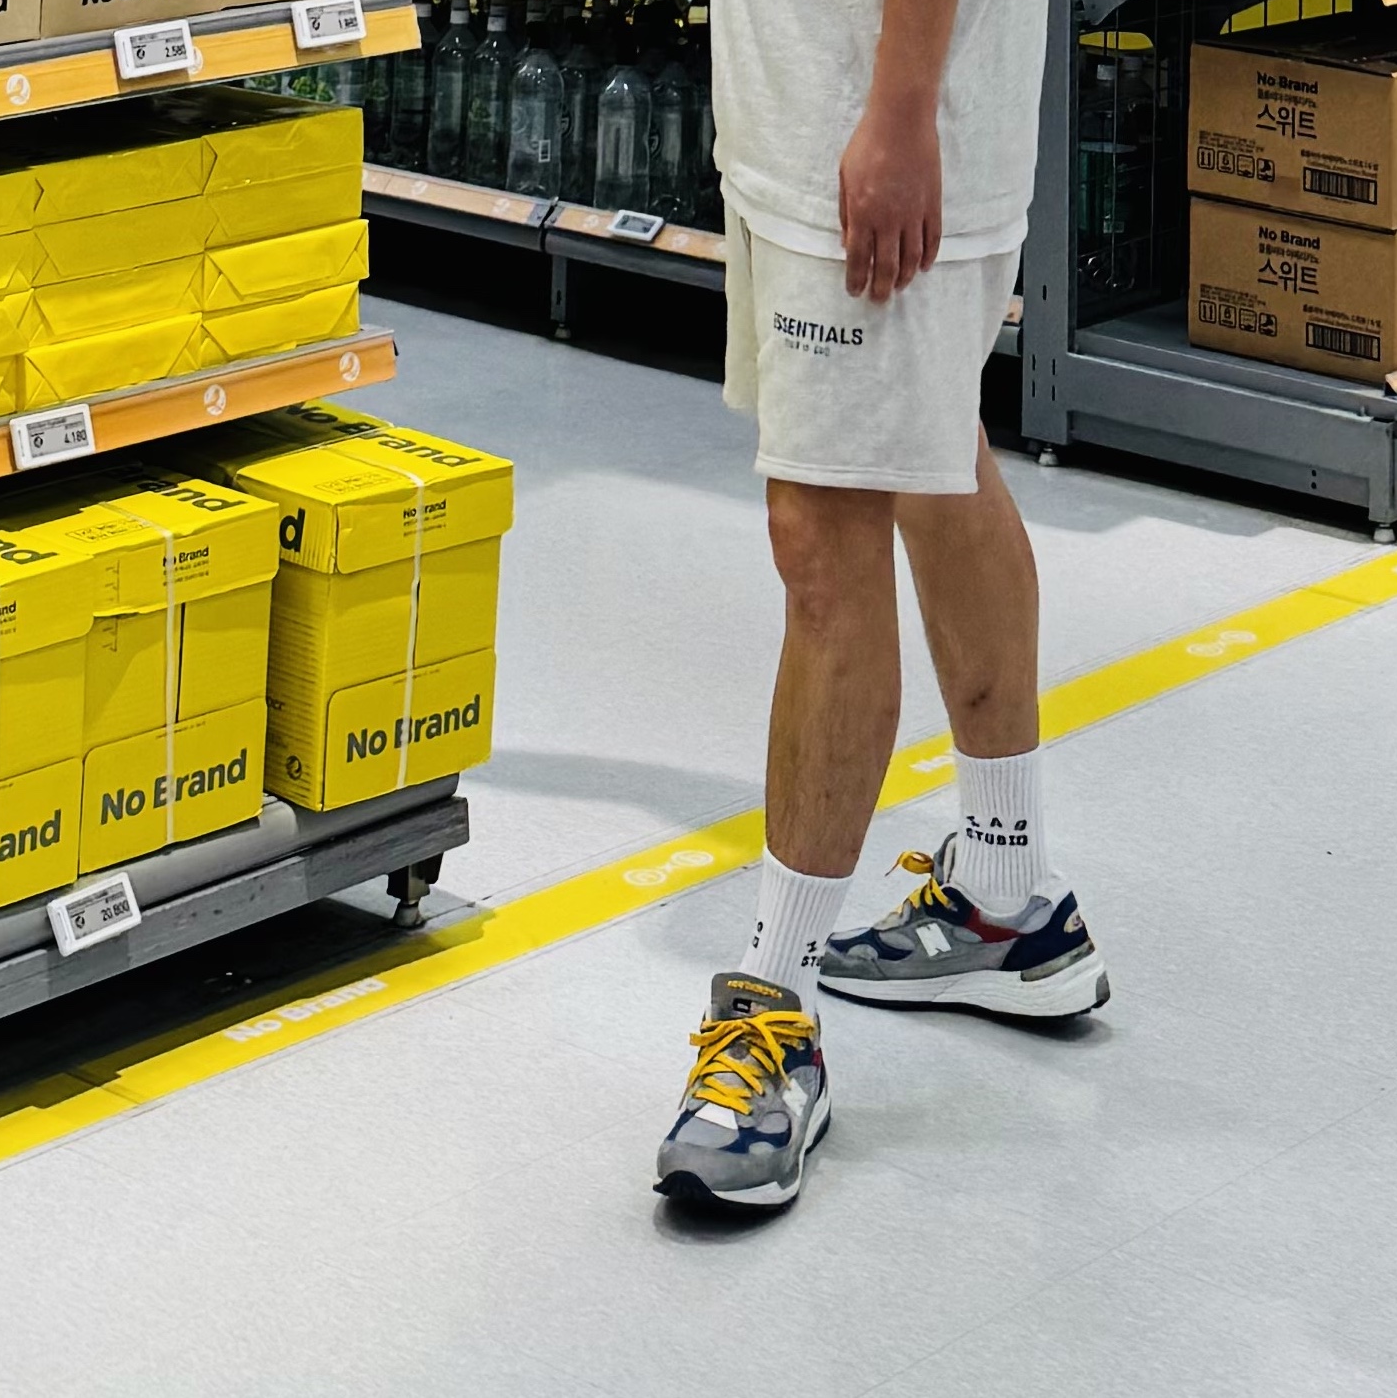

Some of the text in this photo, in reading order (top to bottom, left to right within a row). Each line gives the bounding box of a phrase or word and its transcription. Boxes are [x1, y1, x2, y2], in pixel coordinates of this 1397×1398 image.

[1256, 70, 1319, 95] No Brand
[1255, 103, 1318, 141] 스위트
[1258, 225, 1321, 252] No Brand
[1256, 258, 1320, 295] 스위트
[346, 694, 481, 764] No Brand
[100, 749, 247, 825] No Brand
[966, 828, 1028, 846] STUDIO
